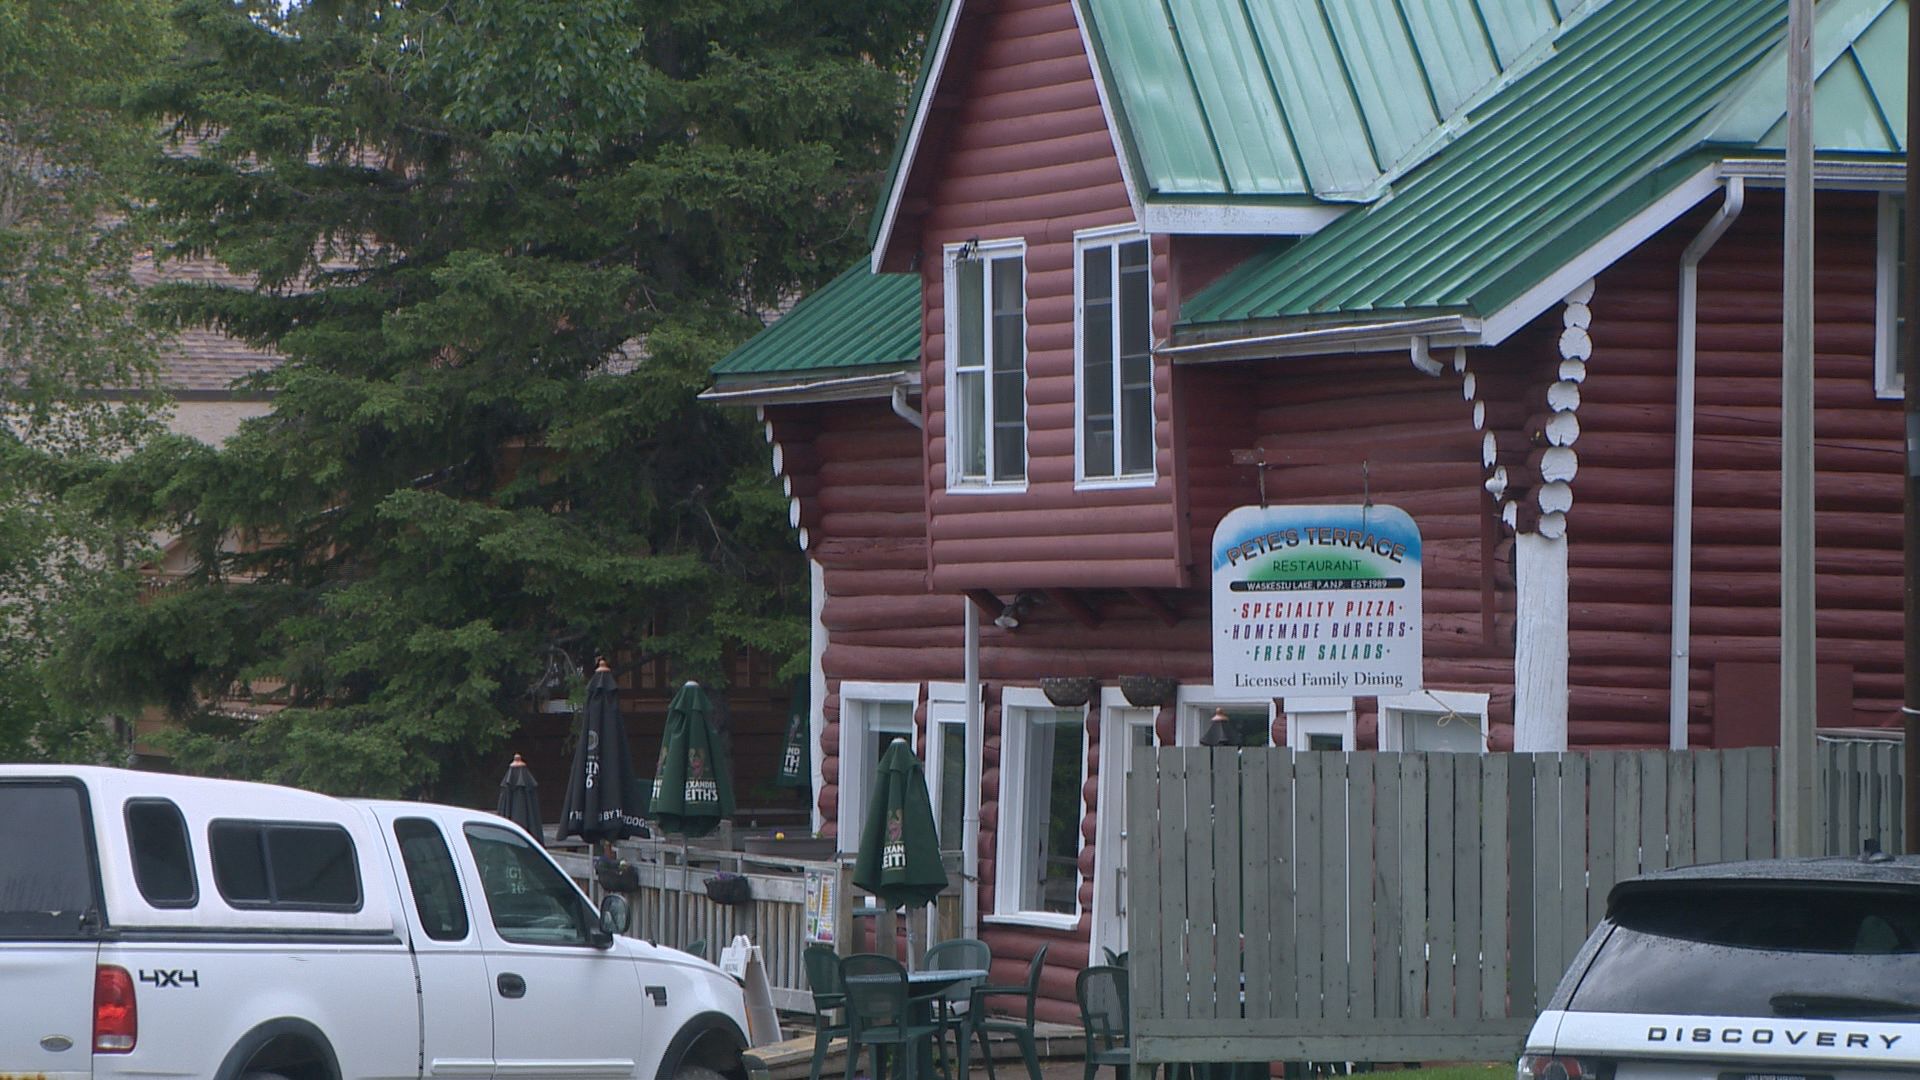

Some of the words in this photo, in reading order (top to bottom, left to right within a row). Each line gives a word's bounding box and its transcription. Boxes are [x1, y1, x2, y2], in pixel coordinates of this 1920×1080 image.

[1226, 528, 1300, 567] PETE'S
[1304, 527, 1407, 564] TERRACE
[1272, 560, 1362, 573] RESTAURANT
[1247, 581, 1292, 591] WASKESIU
[1241, 601, 1335, 619] SPECIALTY
[1345, 600, 1395, 617] PIZZA
[1232, 622, 1320, 640] HOMEMADE
[1331, 621, 1407, 639] BURGERS
[1254, 645, 1307, 661] FRESH
[1317, 643, 1384, 661] SALADS
[1234, 673, 1297, 688] Licensed
[1302, 672, 1349, 689] Family
[1354, 671, 1404, 688] Dining
[139, 969, 200, 988] 4X4
[1647, 1026, 1903, 1050] DISCOVERY
